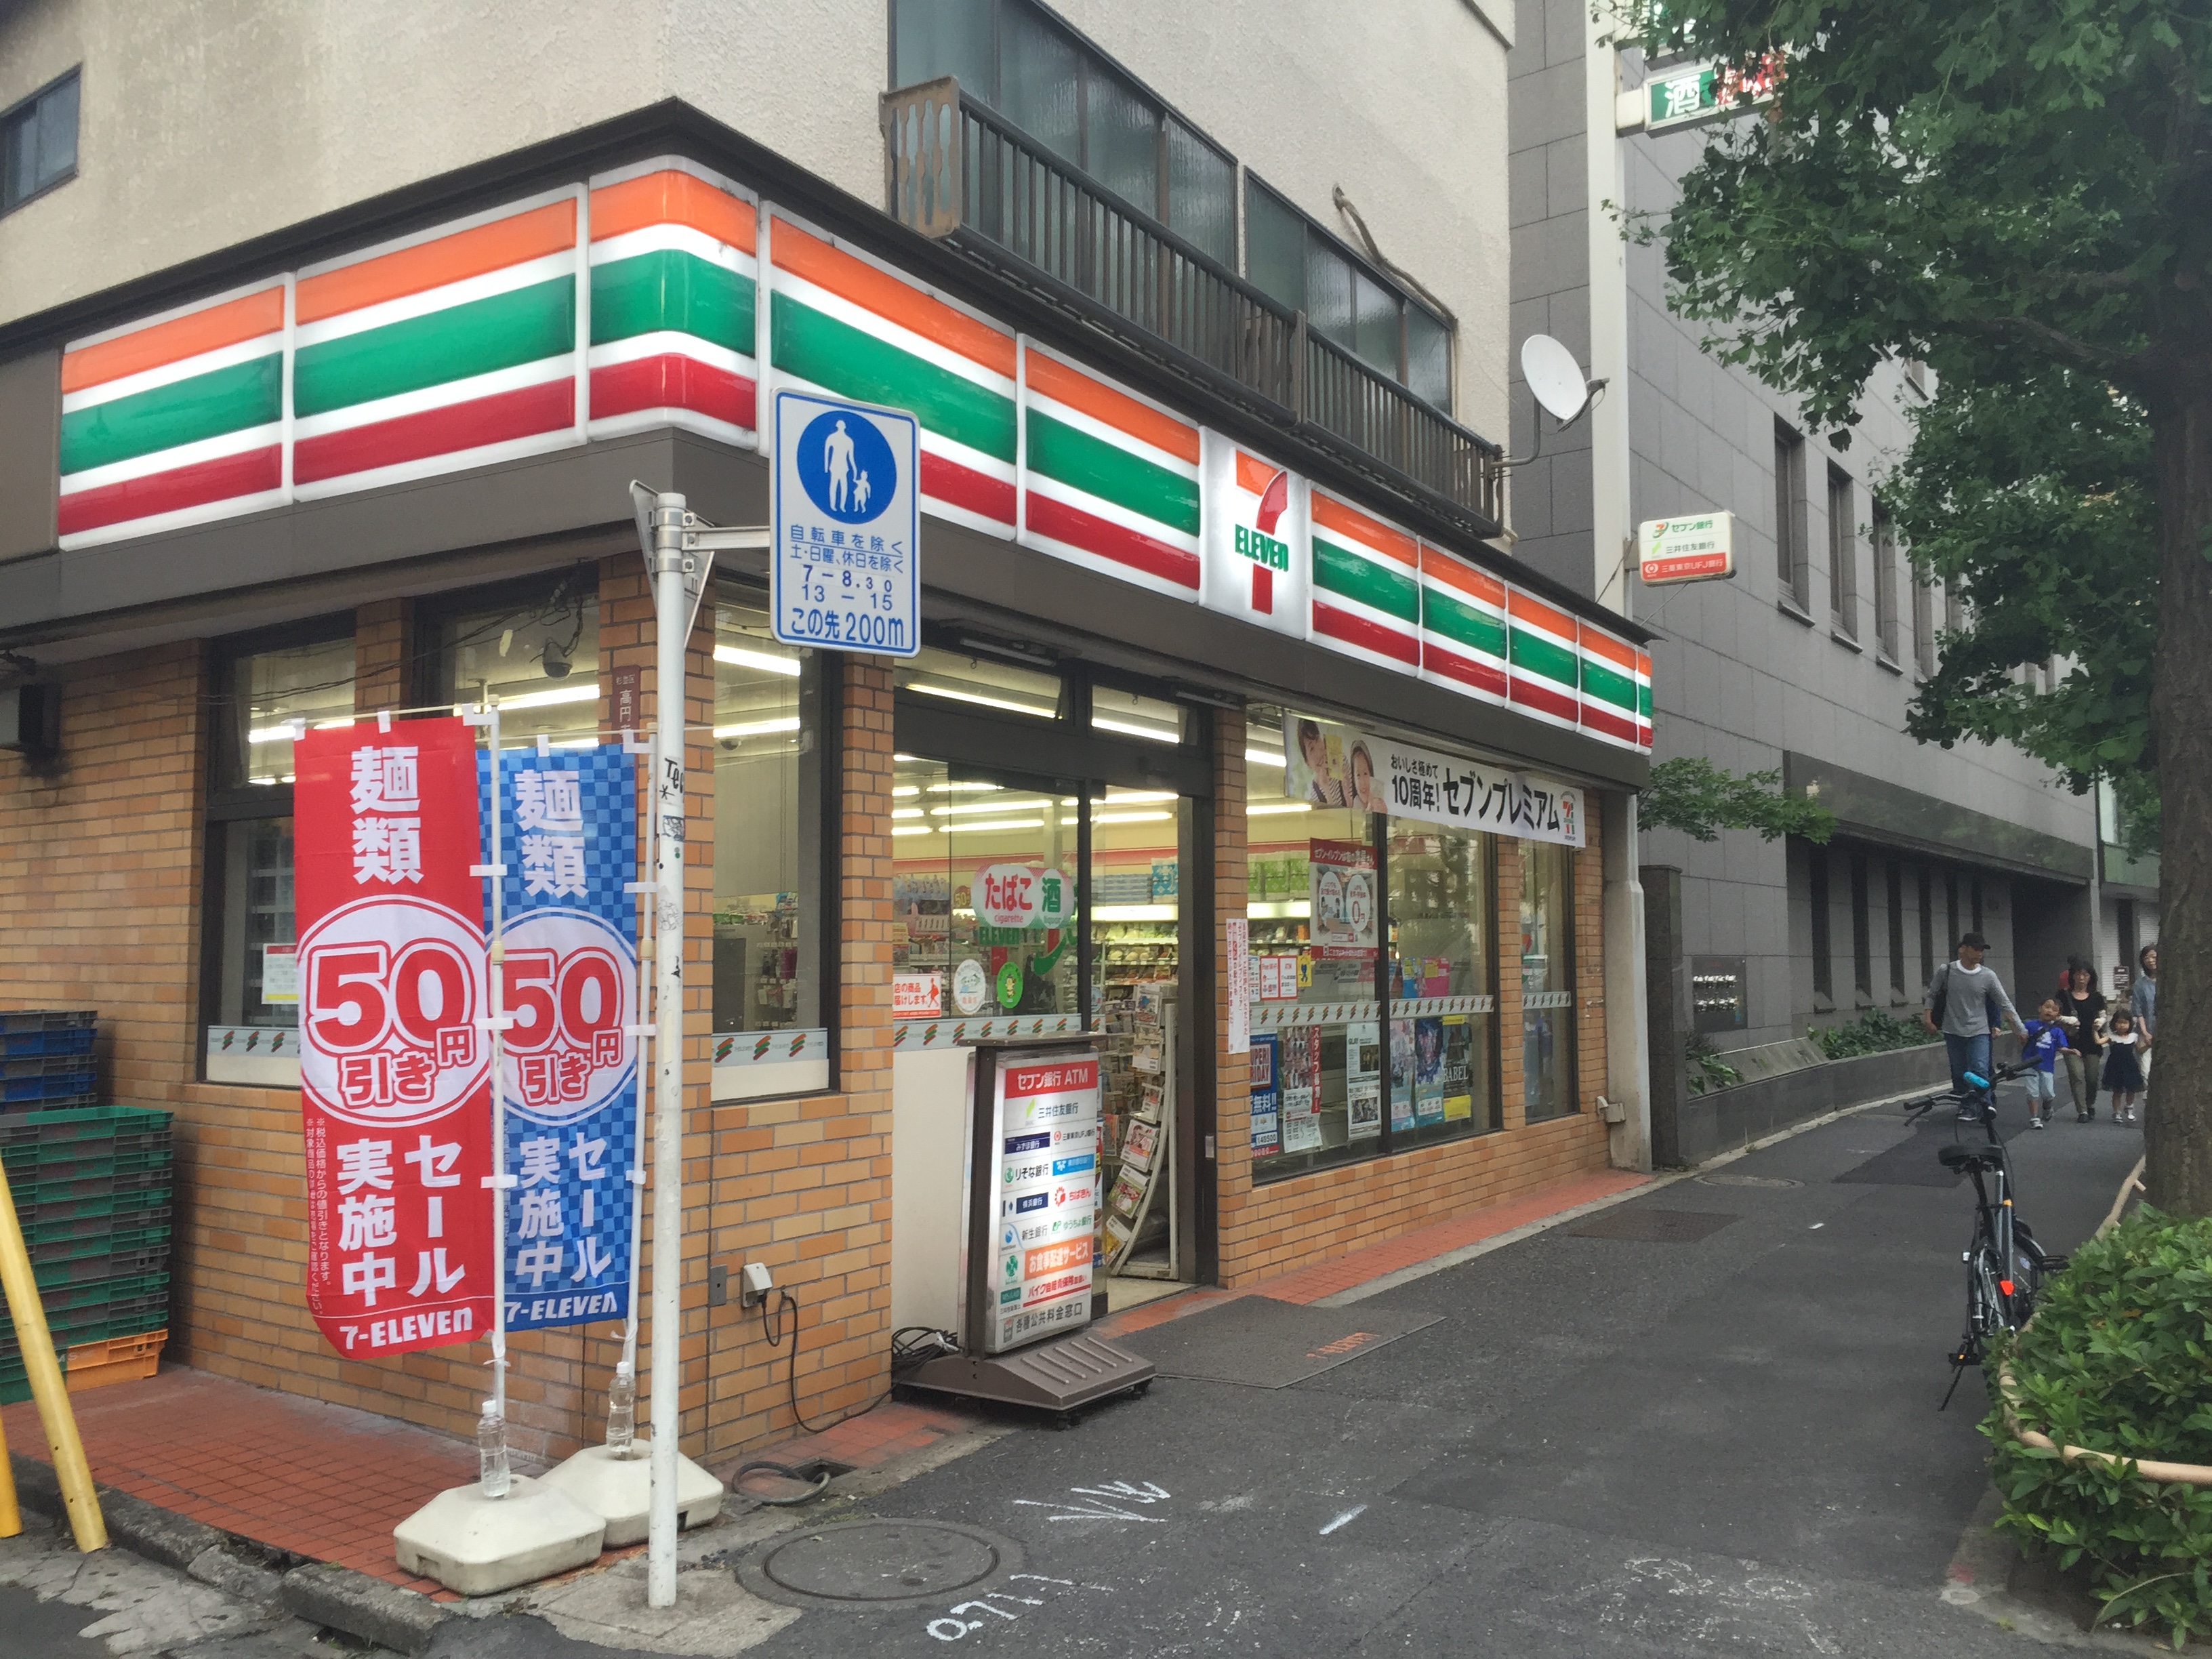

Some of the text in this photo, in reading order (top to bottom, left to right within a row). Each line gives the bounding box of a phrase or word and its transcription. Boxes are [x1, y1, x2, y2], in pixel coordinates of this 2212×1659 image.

[1664, 73, 1701, 119] 酒
[790, 524, 903, 556] 自転車を除く
[1671, 520, 1713, 533] セブン銀行
[1666, 541, 1715, 554] 三井住友銀行
[791, 607, 905, 647] この先200m
[1390, 754, 1439, 779] おいしさ極めて
[350, 745, 423, 885] 麺類
[1442, 766, 1561, 833] セブンプレミアム
[515, 769, 589, 899] 麺類
[985, 873, 1033, 912] たばこ
[1042, 876, 1061, 913] 酒
[340, 1052, 436, 1107] 引き
[518, 1053, 591, 1106] 引き
[1017, 1068, 1088, 1090] セブン銀行 ATM
[1443, 1065, 1469, 1083] BABEL
[1038, 1102, 1079, 1119] 三井住友銀行
[1015, 1164, 1049, 1181] りそな銀行
[336, 1137, 397, 1307] 実施中
[404, 1134, 466, 1298] セール
[515, 1135, 565, 1287] 実施中
[568, 1132, 612, 1283] セール
[1021, 1225, 1048, 1241] 新生銀行
[1016, 1302, 1083, 1334] 各種公共料金窓口
